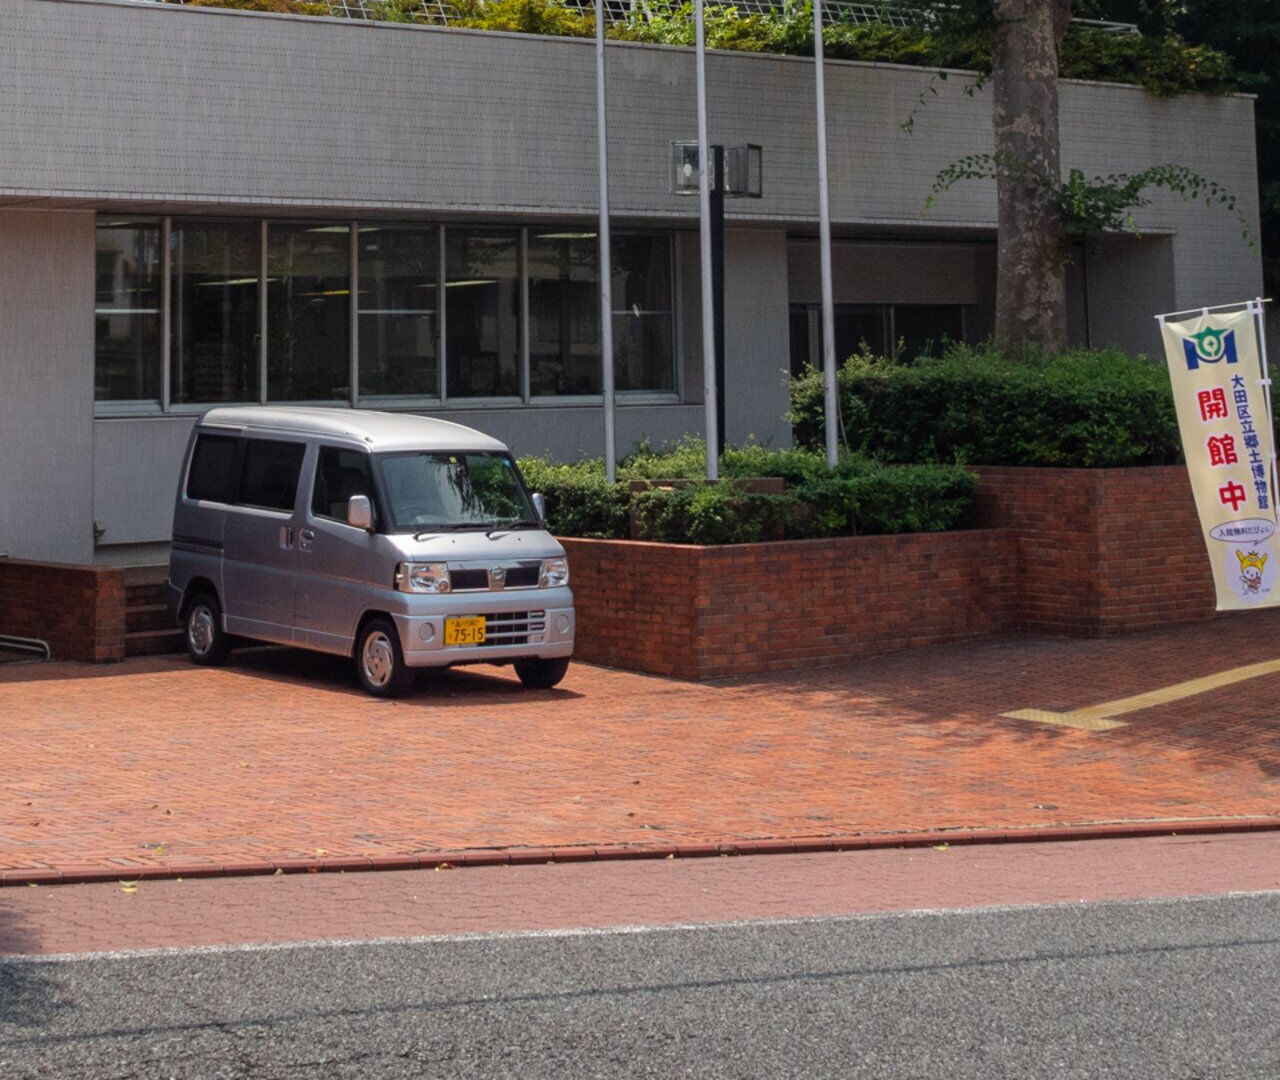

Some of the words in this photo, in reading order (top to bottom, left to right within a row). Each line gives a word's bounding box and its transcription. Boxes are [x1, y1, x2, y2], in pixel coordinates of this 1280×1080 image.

[1197, 388, 1247, 512] 開館中
[1231, 374, 1269, 510] 大田区立郷土博物館
[454, 627, 484, 642] 75-15
